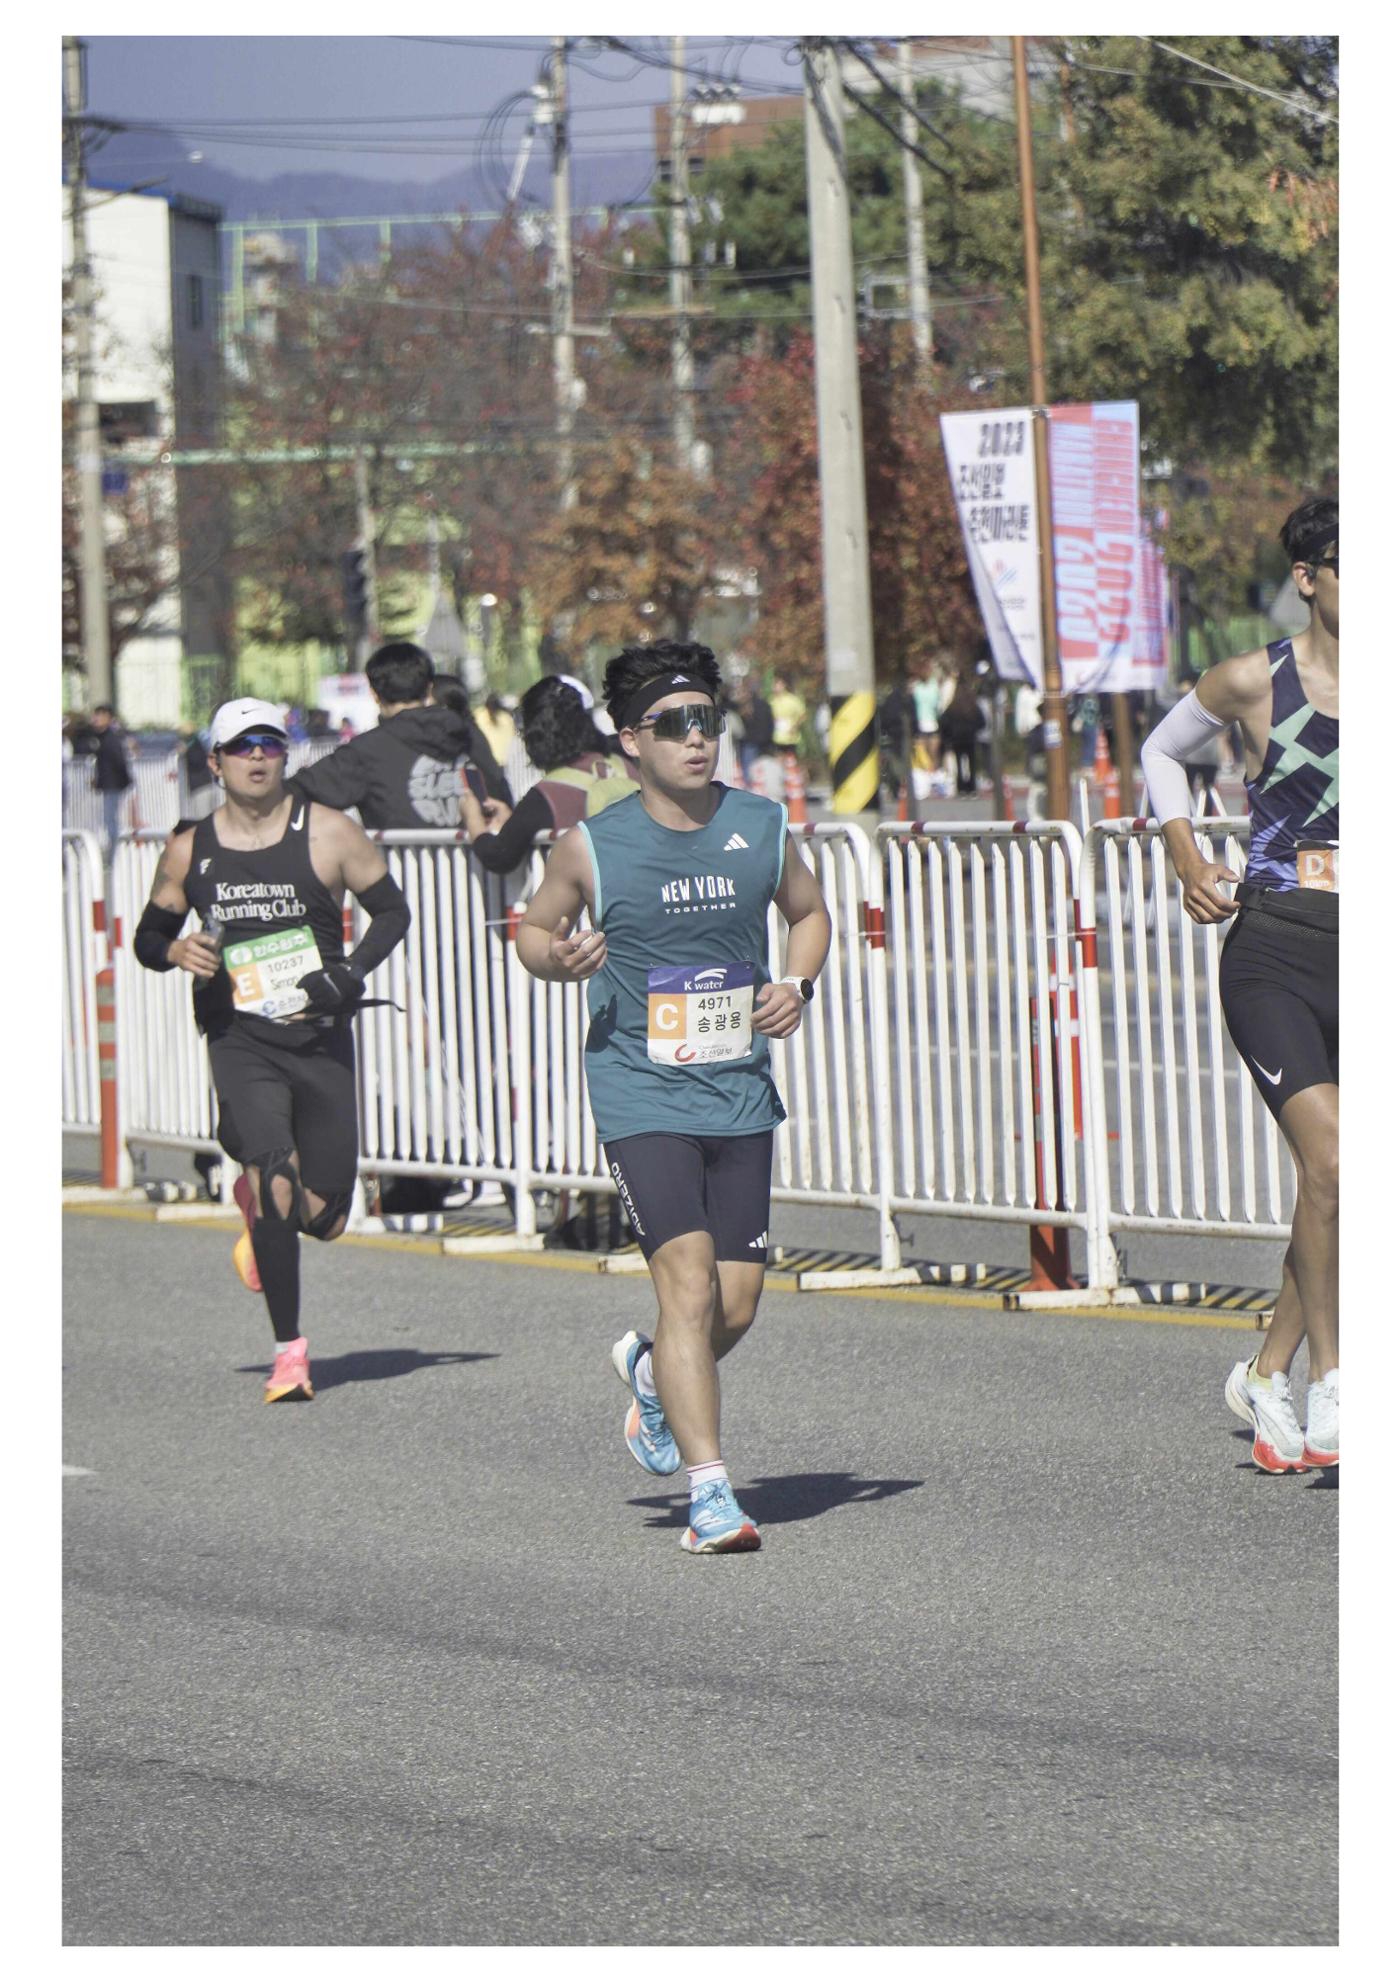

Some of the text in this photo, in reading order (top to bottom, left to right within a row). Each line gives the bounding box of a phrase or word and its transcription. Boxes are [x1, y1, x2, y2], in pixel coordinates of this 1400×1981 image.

[1305, 854, 1325, 876] D
[216, 881, 296, 902] Koreatown
[661, 875, 736, 903] NEW YORK
[210, 899, 307, 922] Running Club
[665, 902, 737, 914] TOGETHER
[267, 955, 304, 973] 10237
[236, 972, 256, 998] E
[684, 980, 724, 991] K water
[698, 996, 732, 1010] 4971
[655, 1003, 679, 1031] C
[611, 1162, 646, 1236] ADIZERO
